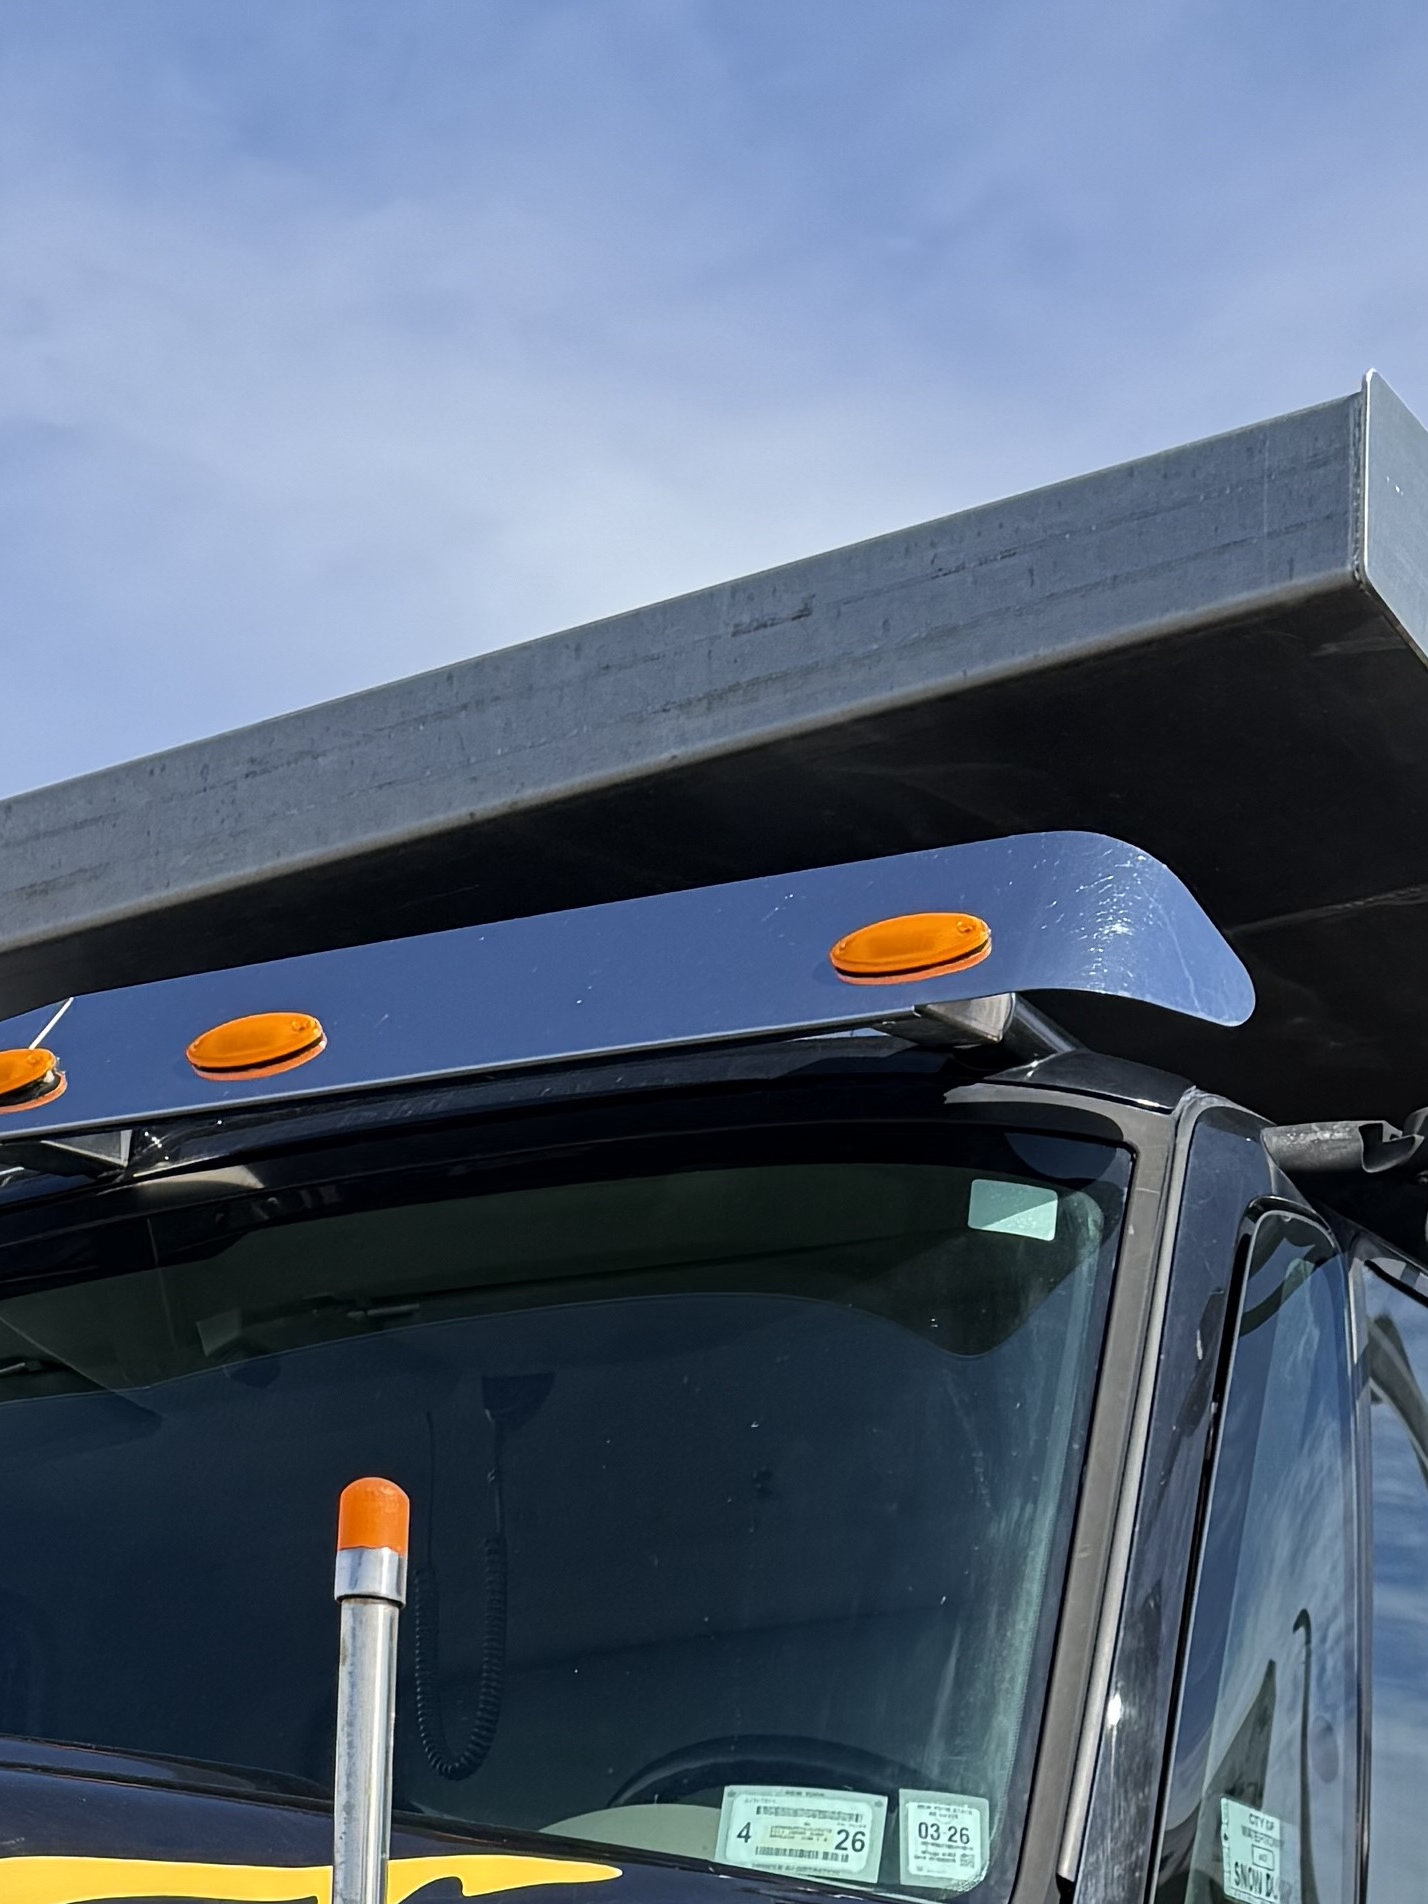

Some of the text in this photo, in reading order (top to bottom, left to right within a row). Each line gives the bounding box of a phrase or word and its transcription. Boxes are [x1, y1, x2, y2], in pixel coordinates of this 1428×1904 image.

[736, 1821, 753, 1844] 4
[834, 1829, 867, 1853] 26
[1234, 1861, 1263, 1896] SNOW
